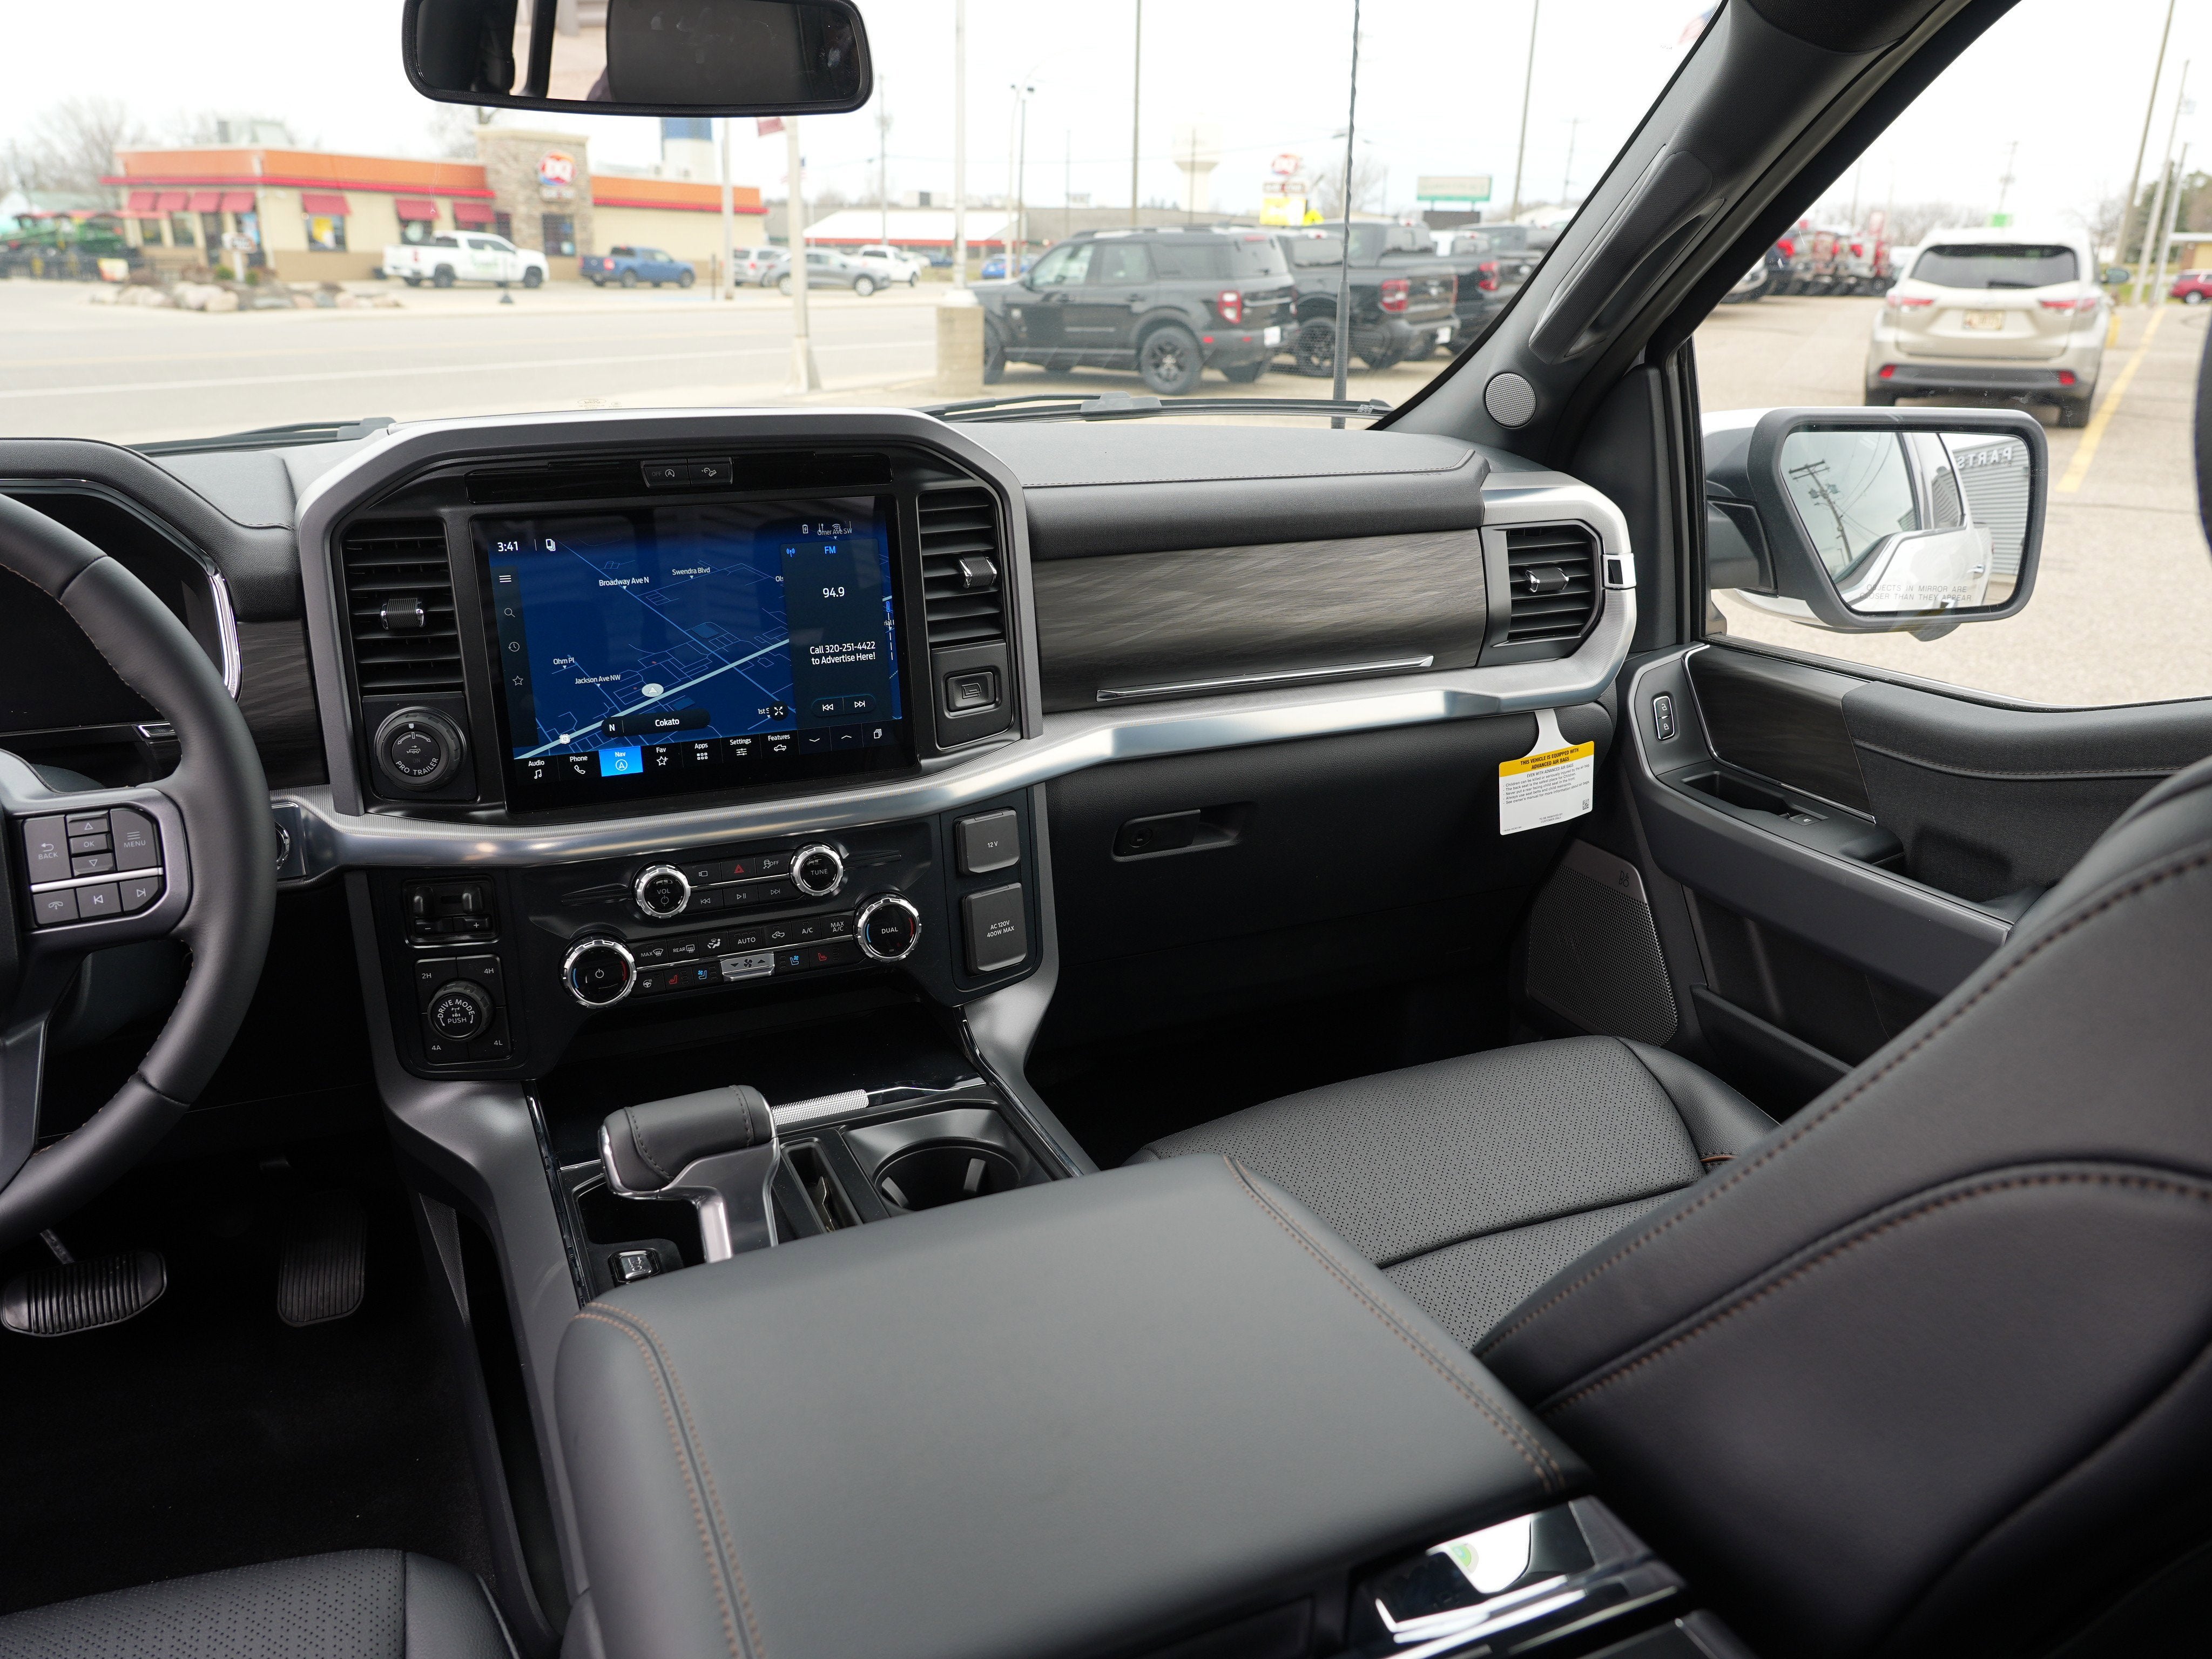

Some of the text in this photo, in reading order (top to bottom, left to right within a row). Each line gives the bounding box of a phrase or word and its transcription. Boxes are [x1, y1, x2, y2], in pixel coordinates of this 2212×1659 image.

[497, 541, 518, 552] 3:41
[825, 546, 836, 554] FM
[599, 578, 631, 586] Broadway
[822, 586, 845, 598] 94.9
[810, 641, 875, 655] Call 320-251-4422
[821, 655, 855, 664] Advertise
[857, 652, 875, 661] Here!
[655, 718, 679, 726] Cokato
[396, 758, 439, 775] PRO TRAILER
[1532, 761, 1552, 770] ADVANCED
[987, 926, 1014, 938] 400W MAX
[437, 999, 475, 1019] DRIVE MODE
